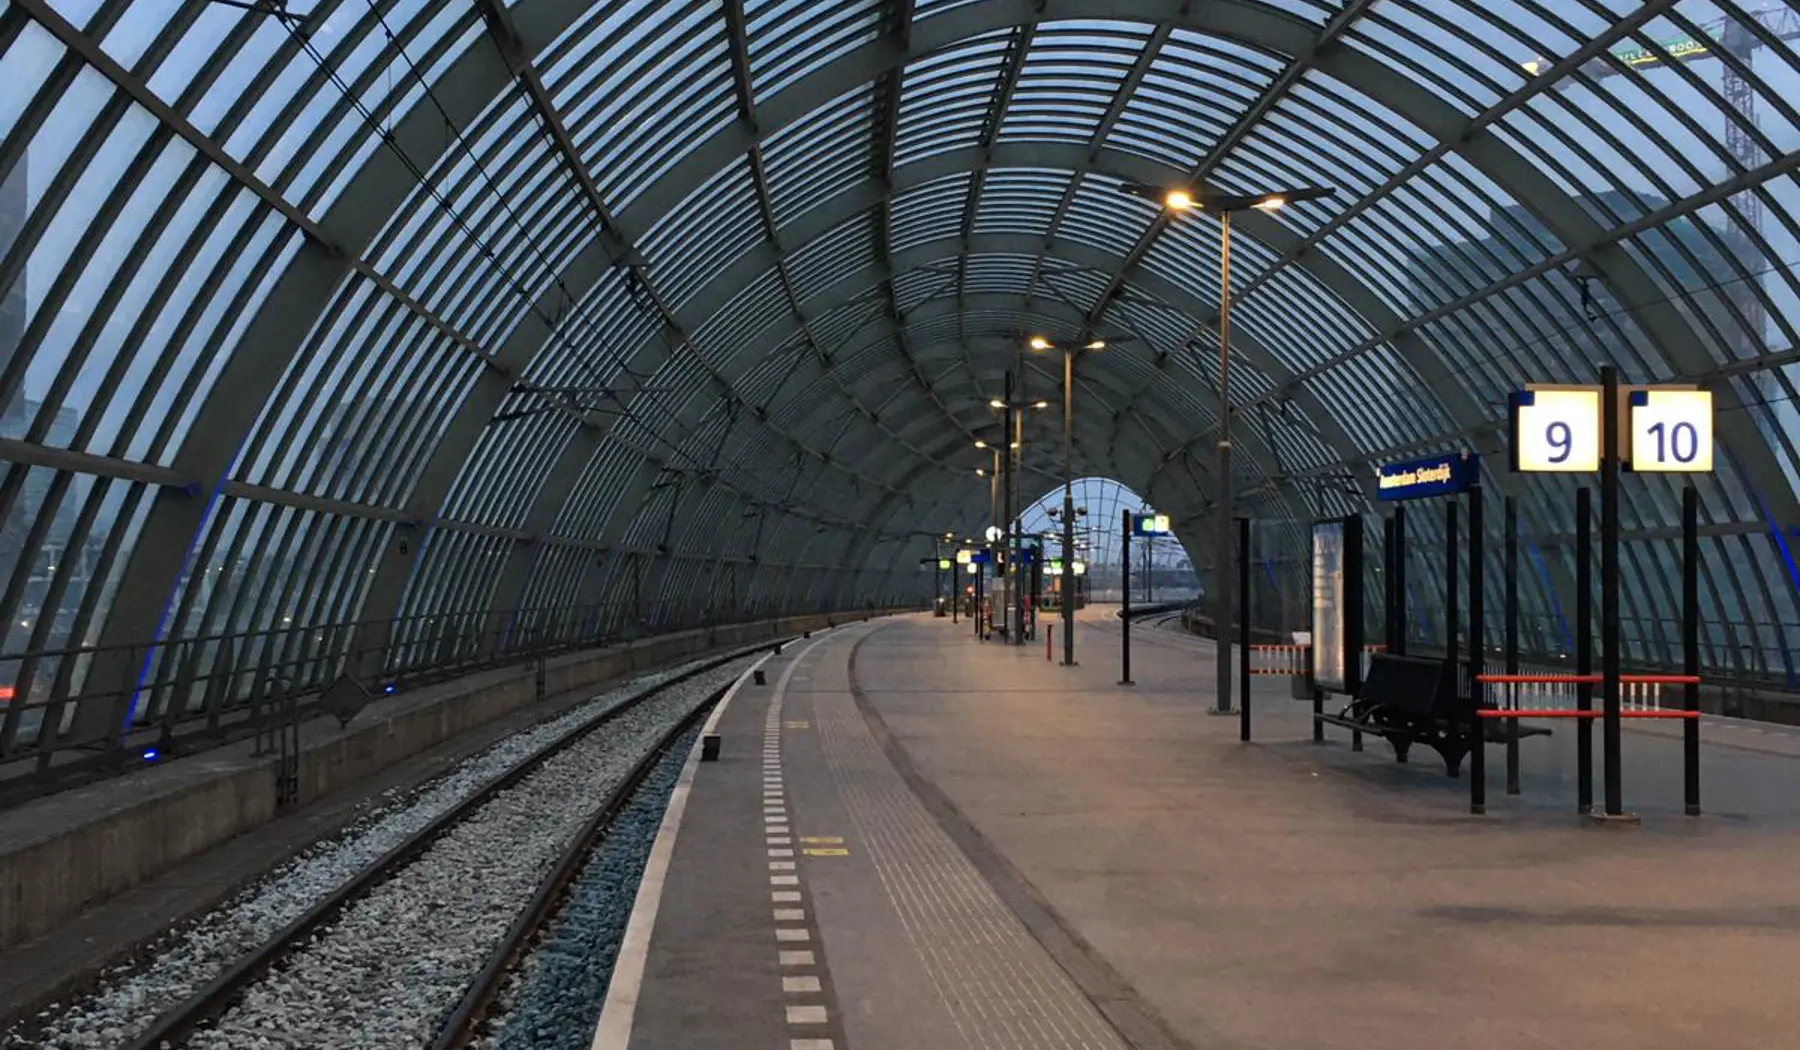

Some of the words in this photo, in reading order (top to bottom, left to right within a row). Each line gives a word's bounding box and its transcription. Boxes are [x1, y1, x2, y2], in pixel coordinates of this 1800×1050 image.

[1546, 421, 1572, 463] 9
[1647, 421, 1698, 463] 10
[1380, 470, 1417, 489] Amsterdam
